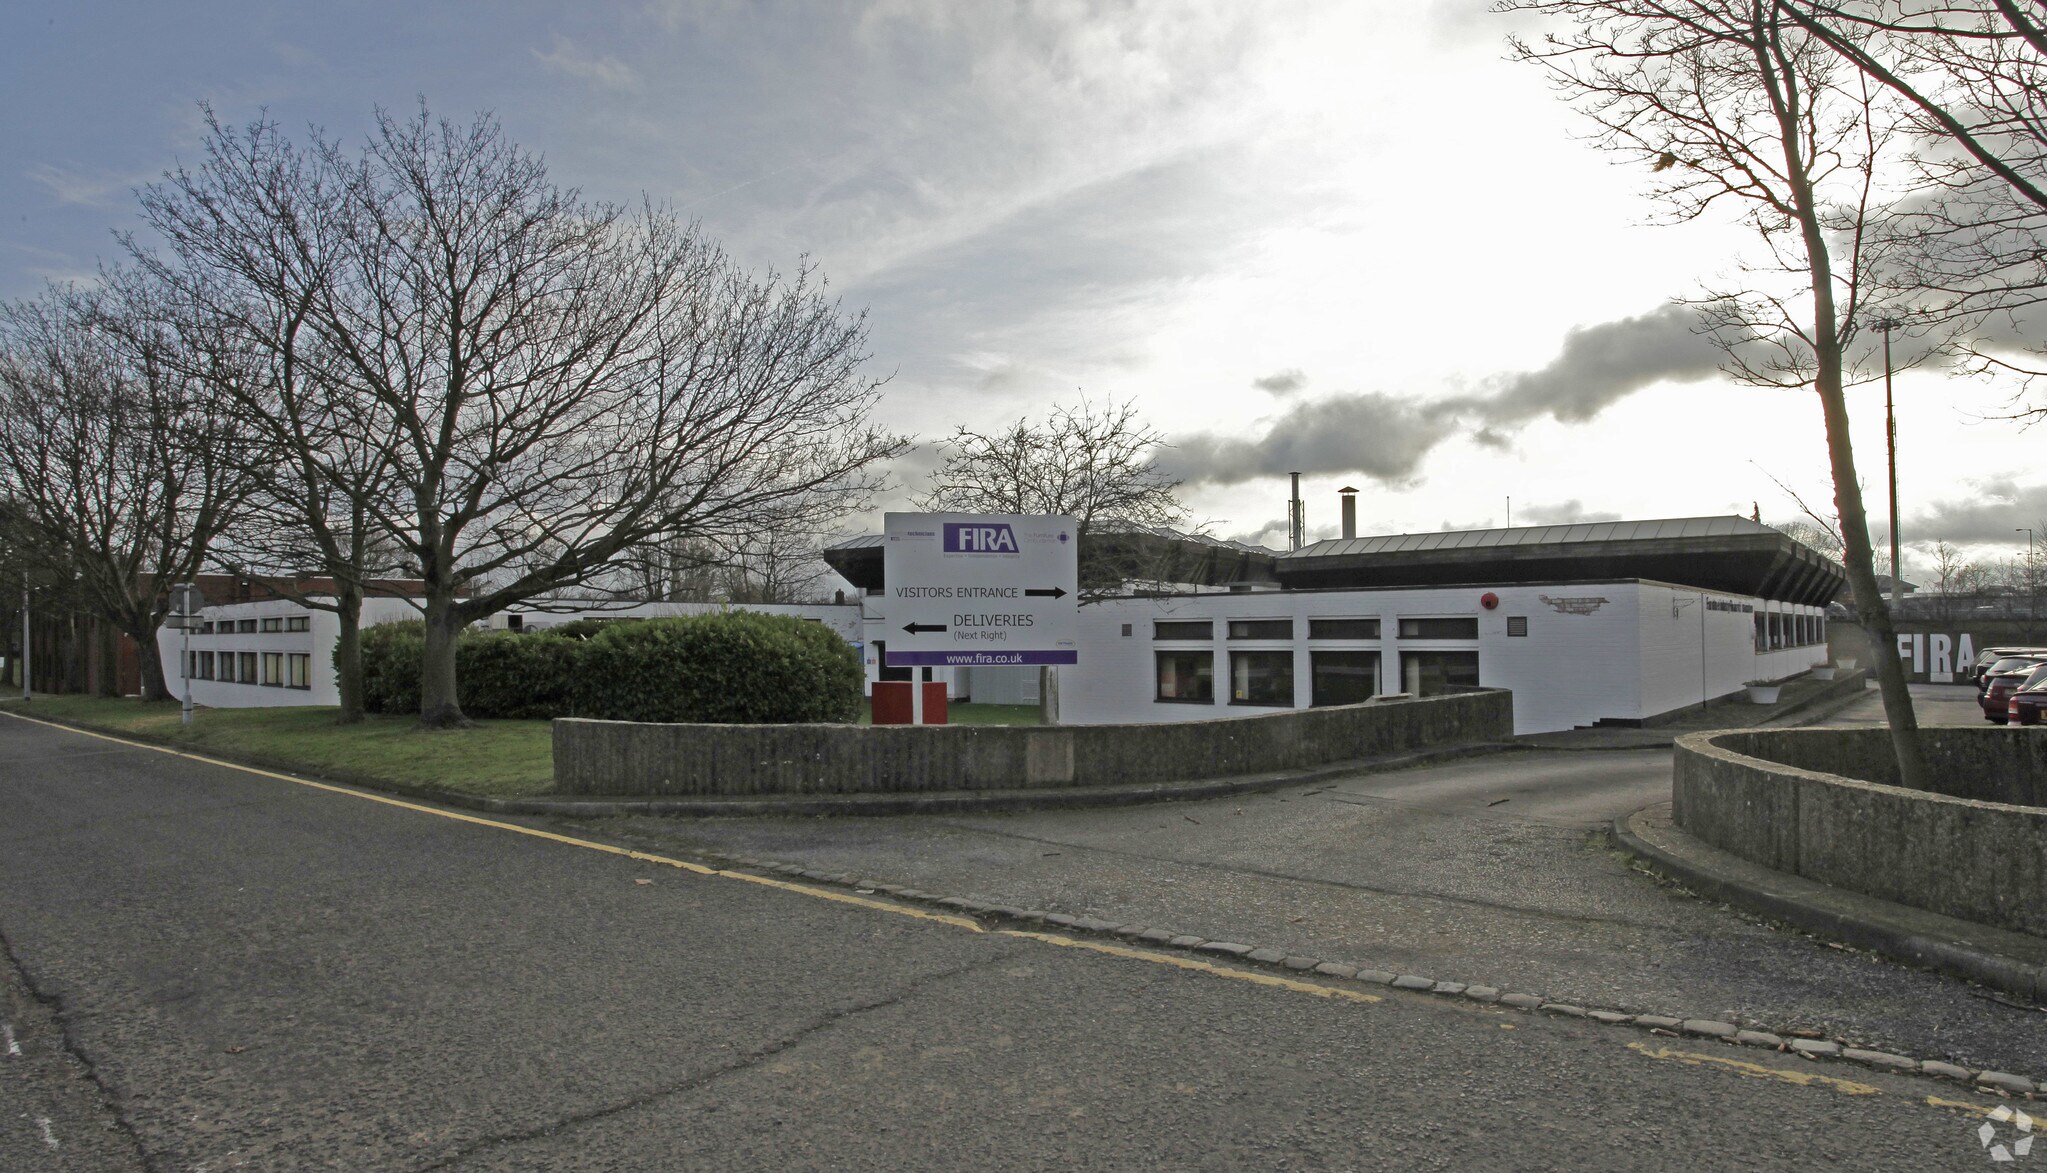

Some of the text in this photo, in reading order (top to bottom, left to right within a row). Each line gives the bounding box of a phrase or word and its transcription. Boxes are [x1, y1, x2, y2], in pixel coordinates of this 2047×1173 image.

[959, 528, 1015, 551] FIRA
[896, 587, 1018, 598] VISITORS ENTRANCE
[954, 614, 1034, 627] DELIVERIES
[953, 631, 1007, 641] (Next Right)
[946, 653, 1023, 664] www.fira.co.uk
